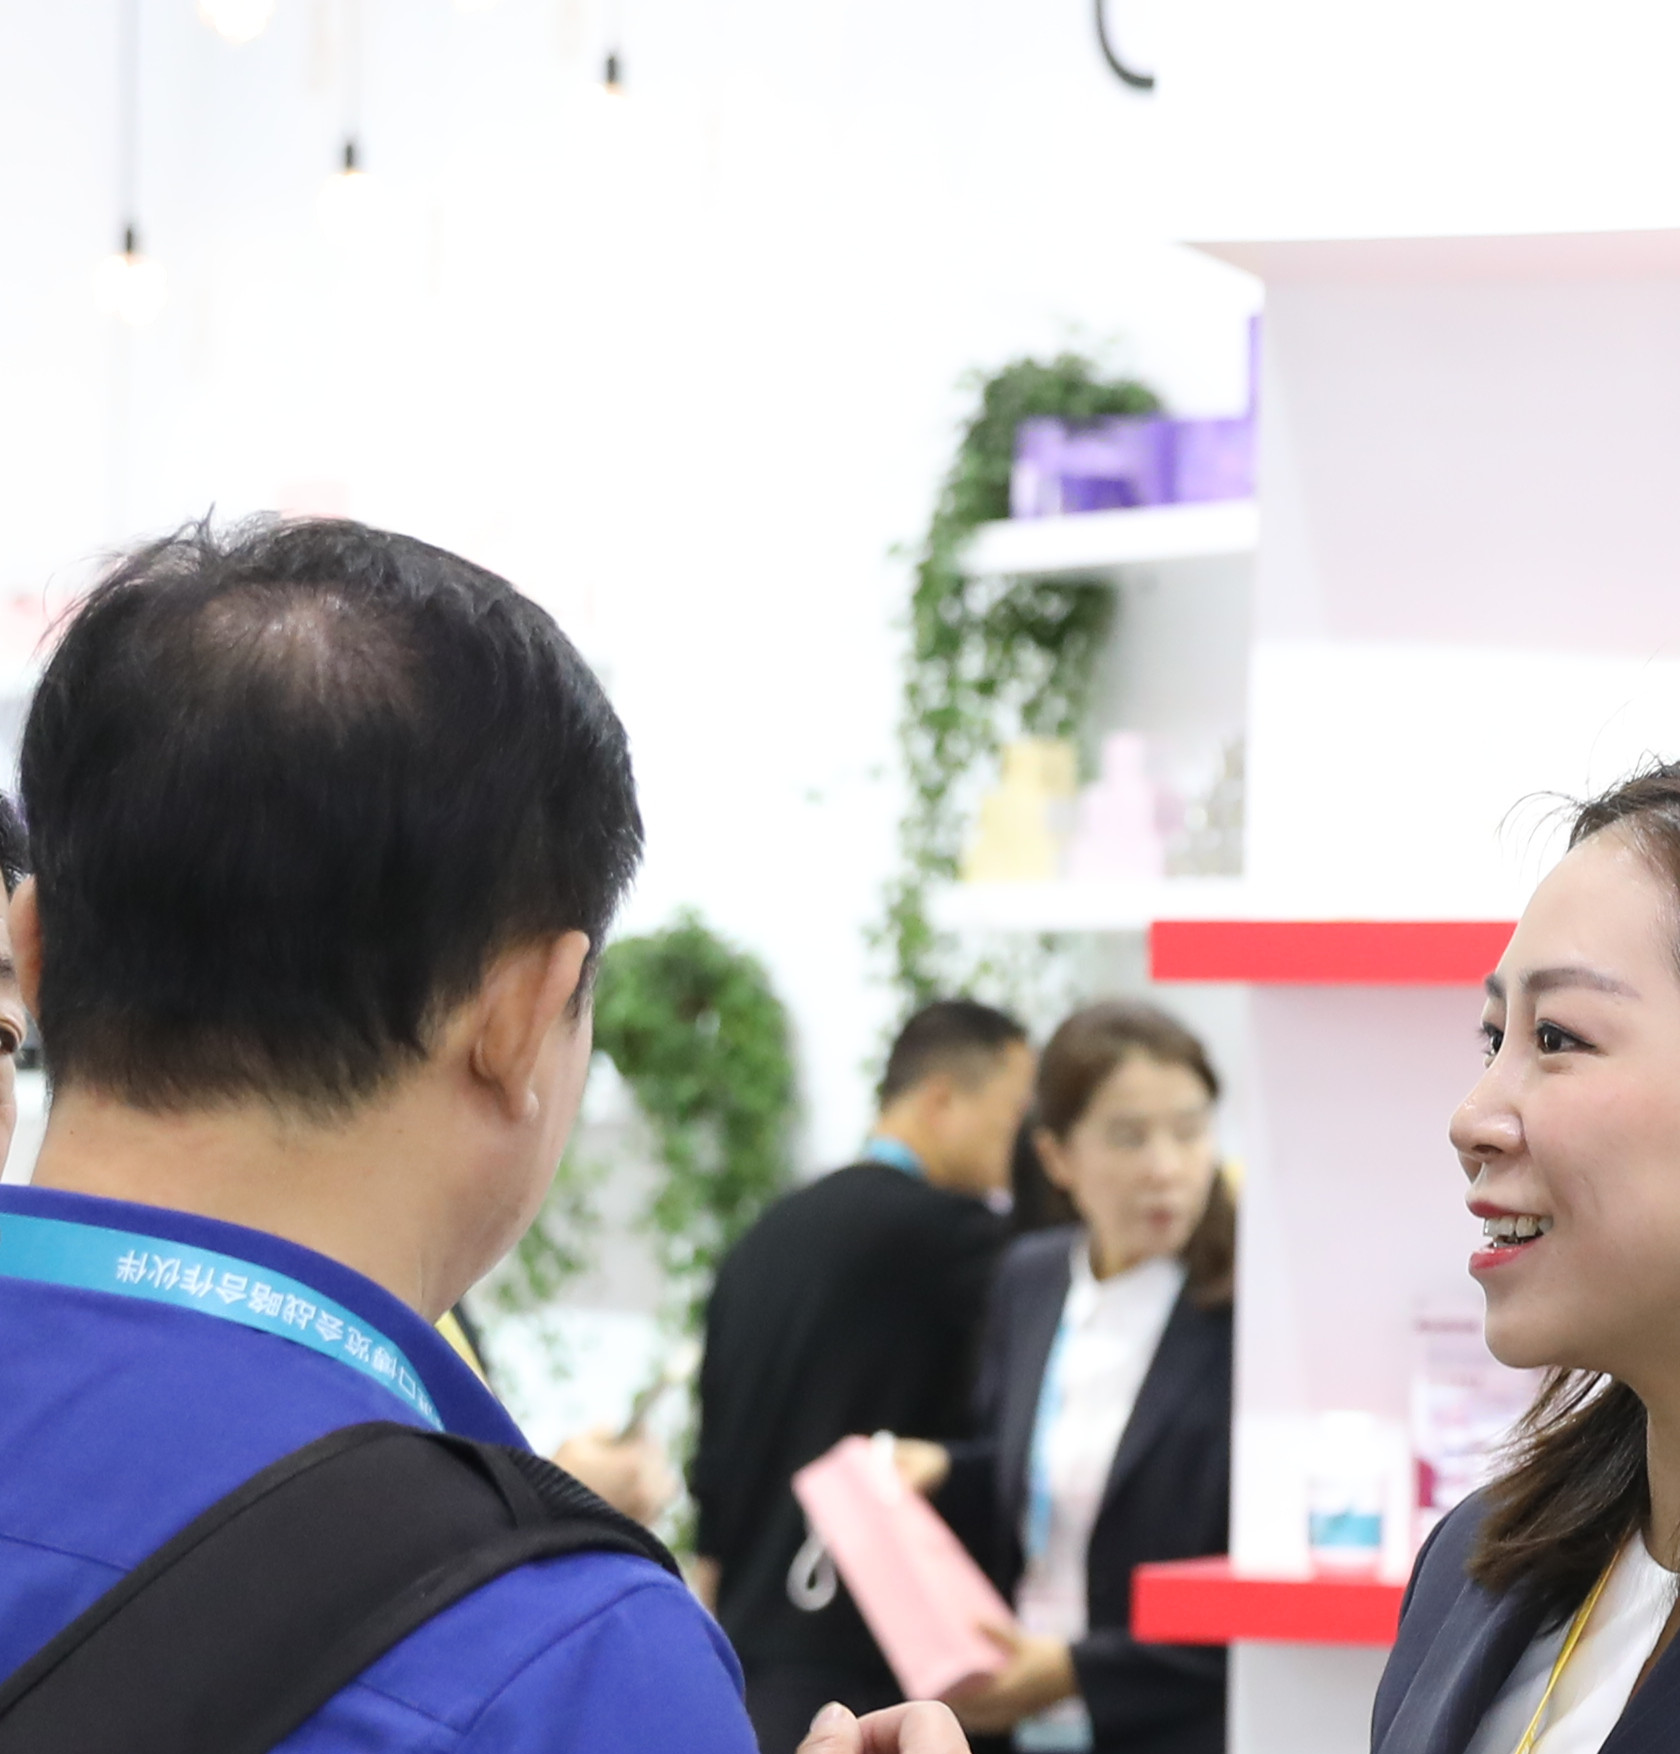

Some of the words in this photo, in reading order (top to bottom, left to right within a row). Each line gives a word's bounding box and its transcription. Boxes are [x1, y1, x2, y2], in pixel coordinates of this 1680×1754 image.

[117, 1250, 434, 1418] 口博览会战略合作伙伴
